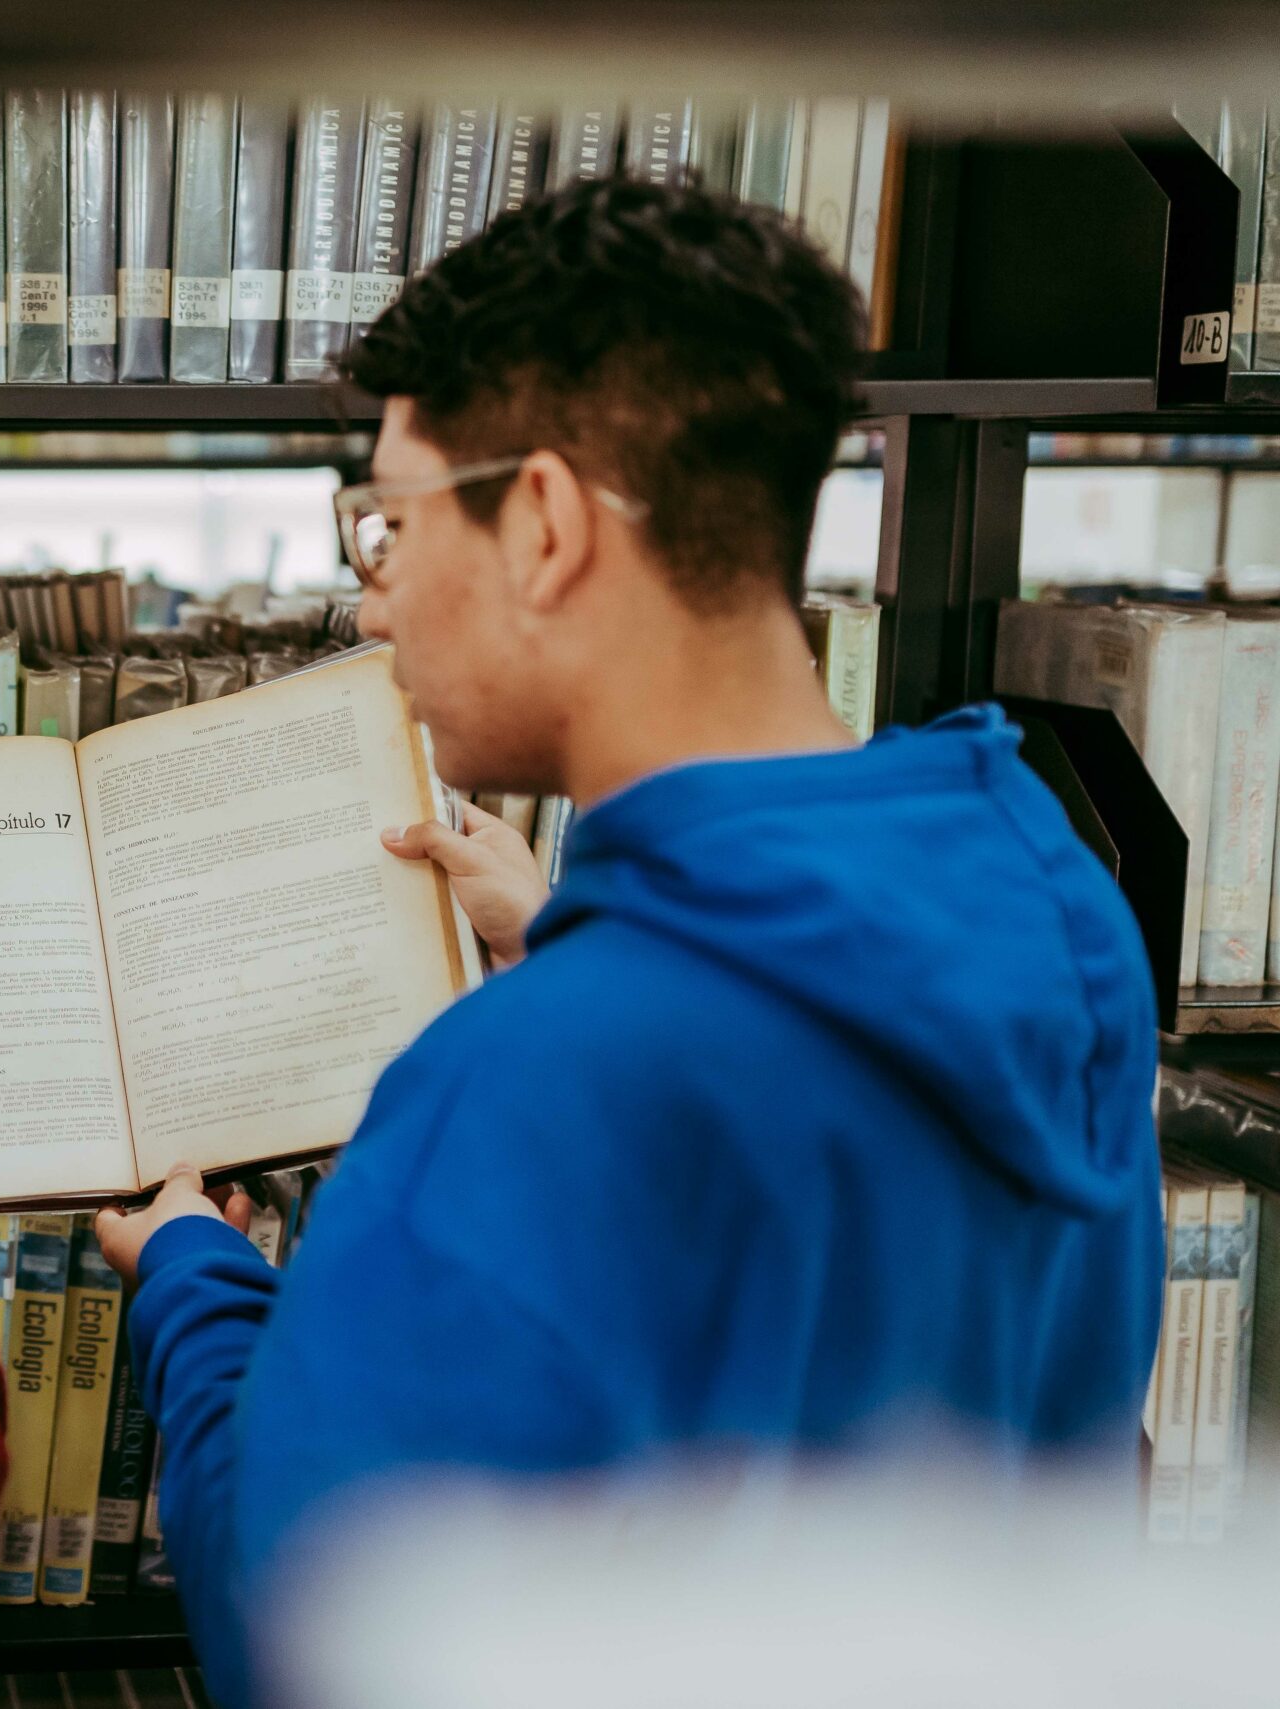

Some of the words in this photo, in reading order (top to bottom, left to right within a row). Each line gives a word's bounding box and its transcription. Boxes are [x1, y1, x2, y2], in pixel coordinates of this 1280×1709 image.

[20, 291, 57, 301] CenTe
[178, 292, 217, 302] CenTe
[21, 302, 48, 312] 1996
[1184, 316, 1223, 354] 10-B
[55, 813, 72, 829] 17
[113, 904, 146, 919] CONSTANTE
[13, 1299, 57, 1393] Ecología
[67, 1297, 113, 1390] Ecología
